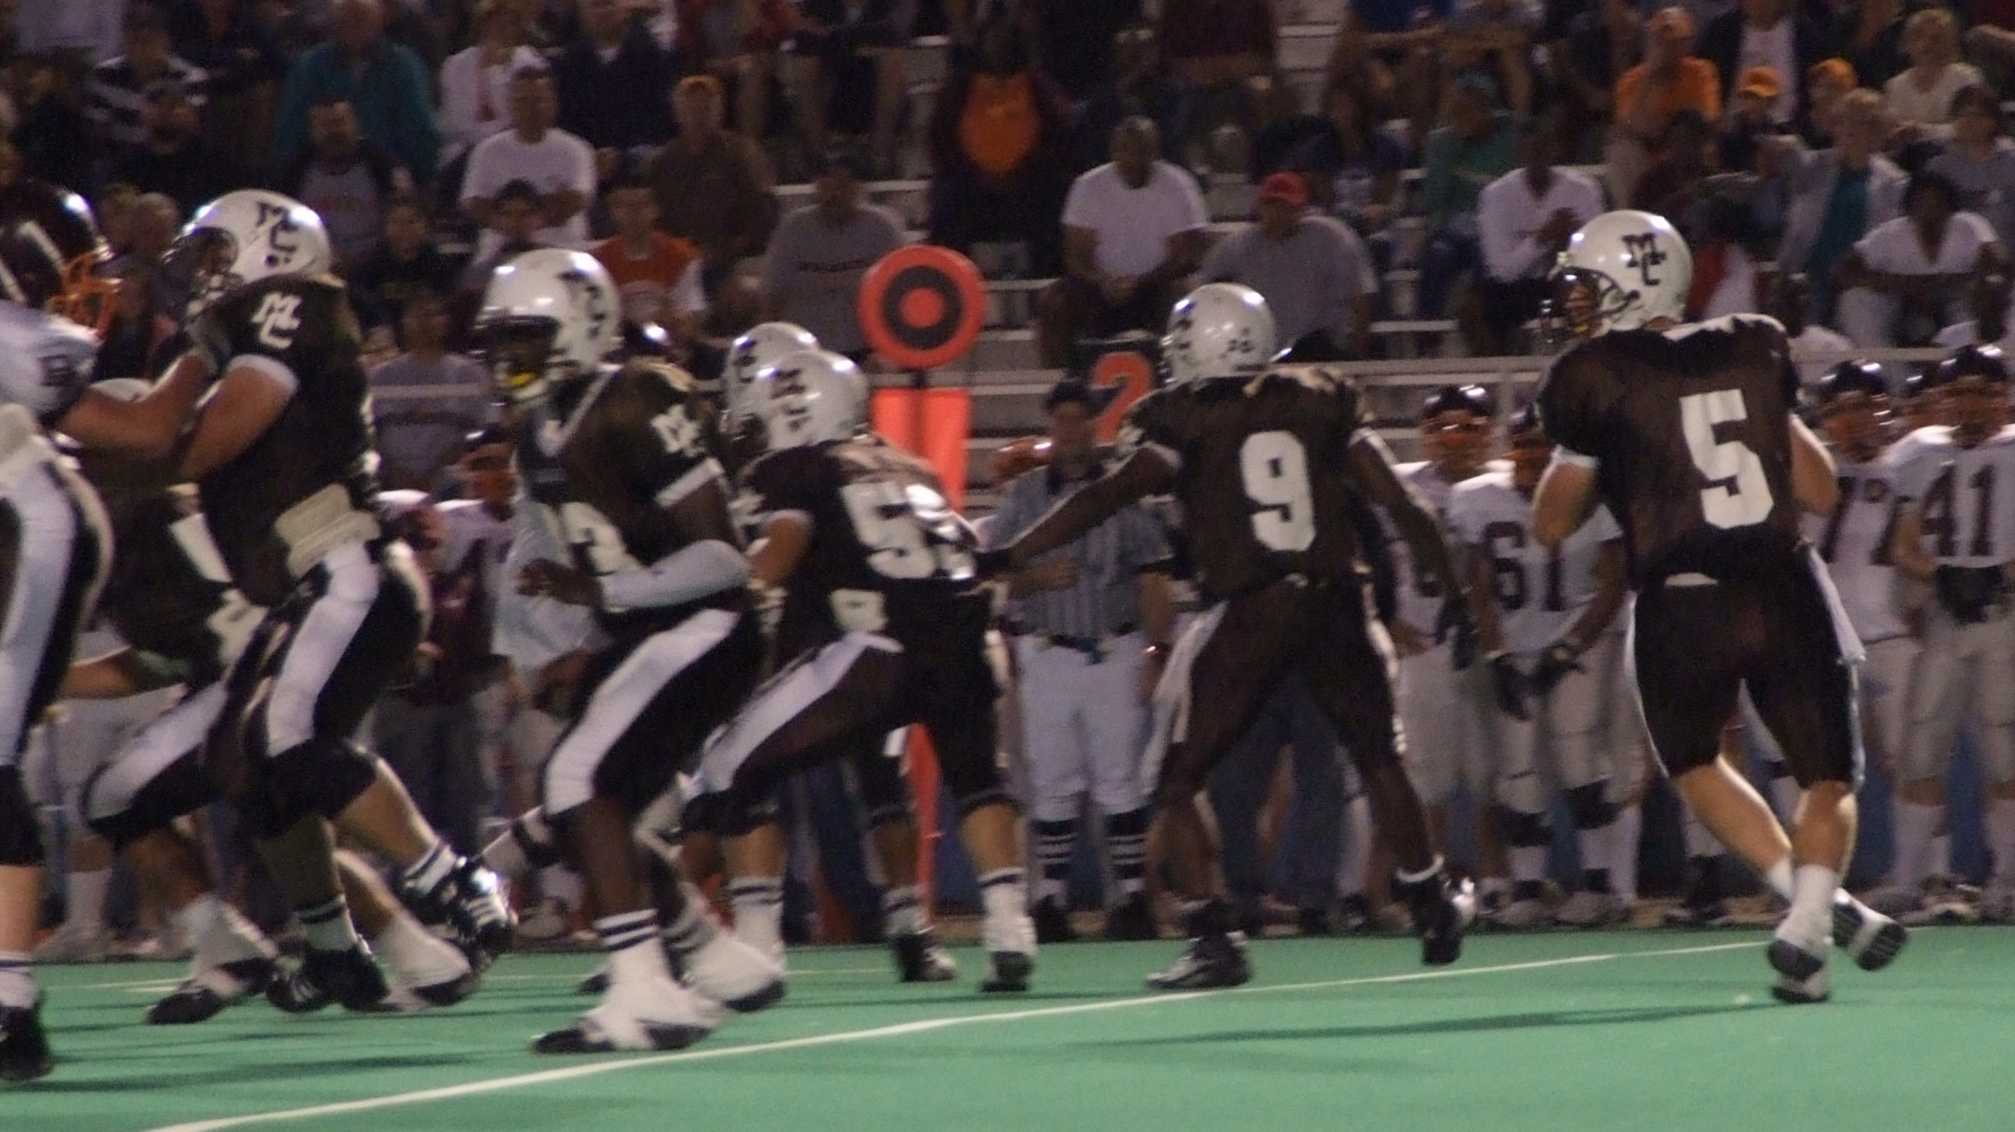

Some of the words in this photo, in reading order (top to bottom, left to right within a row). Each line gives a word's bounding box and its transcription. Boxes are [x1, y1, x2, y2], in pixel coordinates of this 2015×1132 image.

[1622, 232, 1666, 285] MC
[252, 292, 301, 349] MC
[1240, 430, 1317, 552] 9
[1680, 389, 1774, 529] 5
[1921, 463, 1996, 557] 41
[1482, 519, 1568, 612] 61
